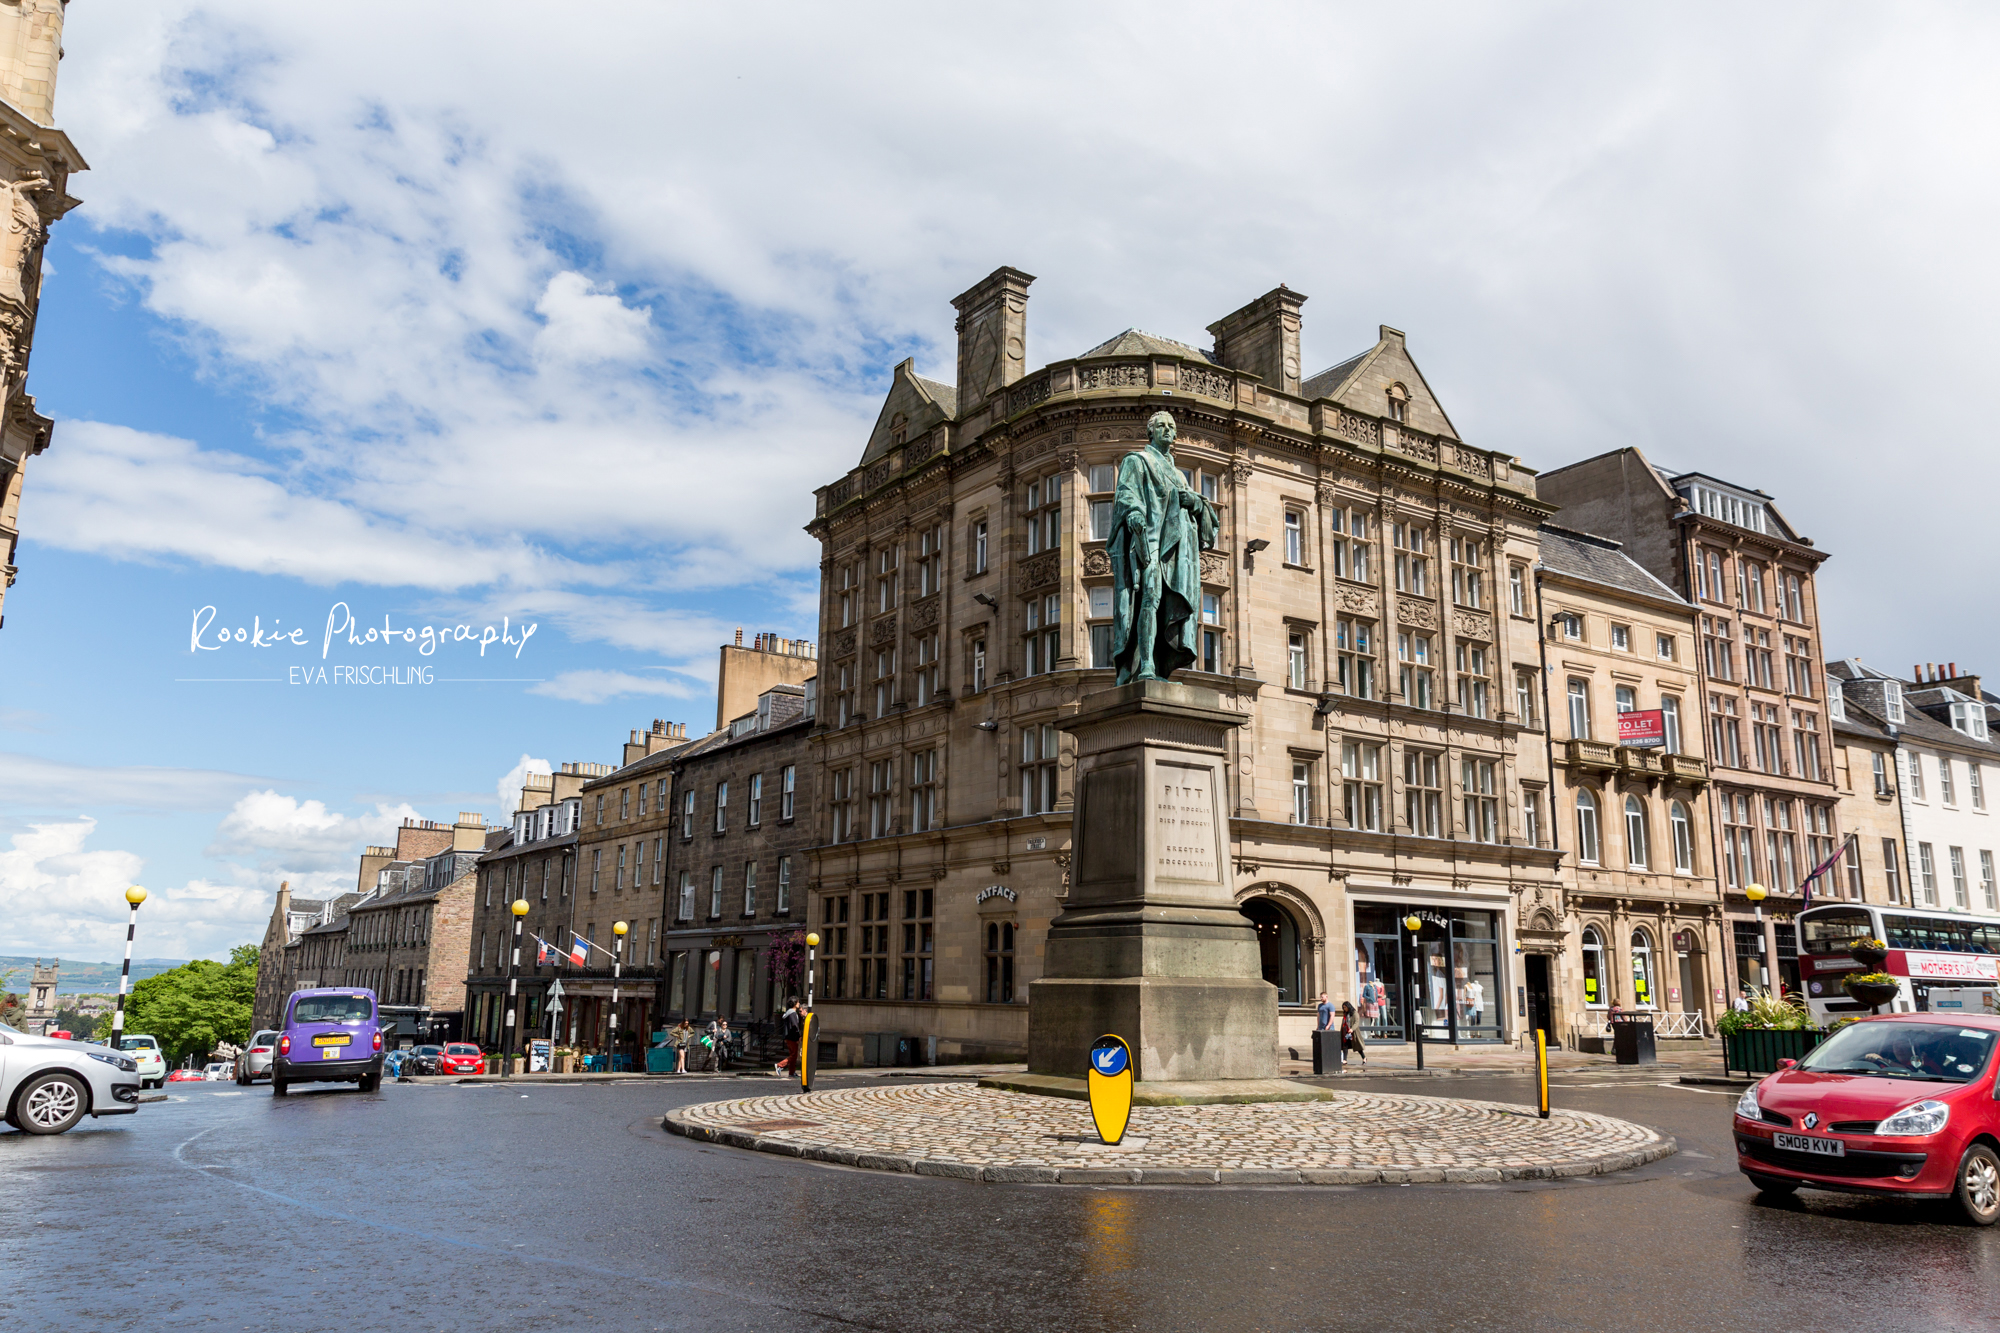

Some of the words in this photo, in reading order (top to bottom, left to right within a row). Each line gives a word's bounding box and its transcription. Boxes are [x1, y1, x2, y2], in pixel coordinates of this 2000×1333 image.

[1618, 721, 1632, 730] TO
[1634, 719, 1653, 728] LET
[1164, 785, 1203, 798] PITT
[976, 885, 1016, 904] FATFACE
[1921, 962, 1960, 975] MOTHER'S
[1960, 964, 1975, 975] DAY
[1778, 1135, 1809, 1149] SM08
[1813, 1139, 1838, 1153] KVW
